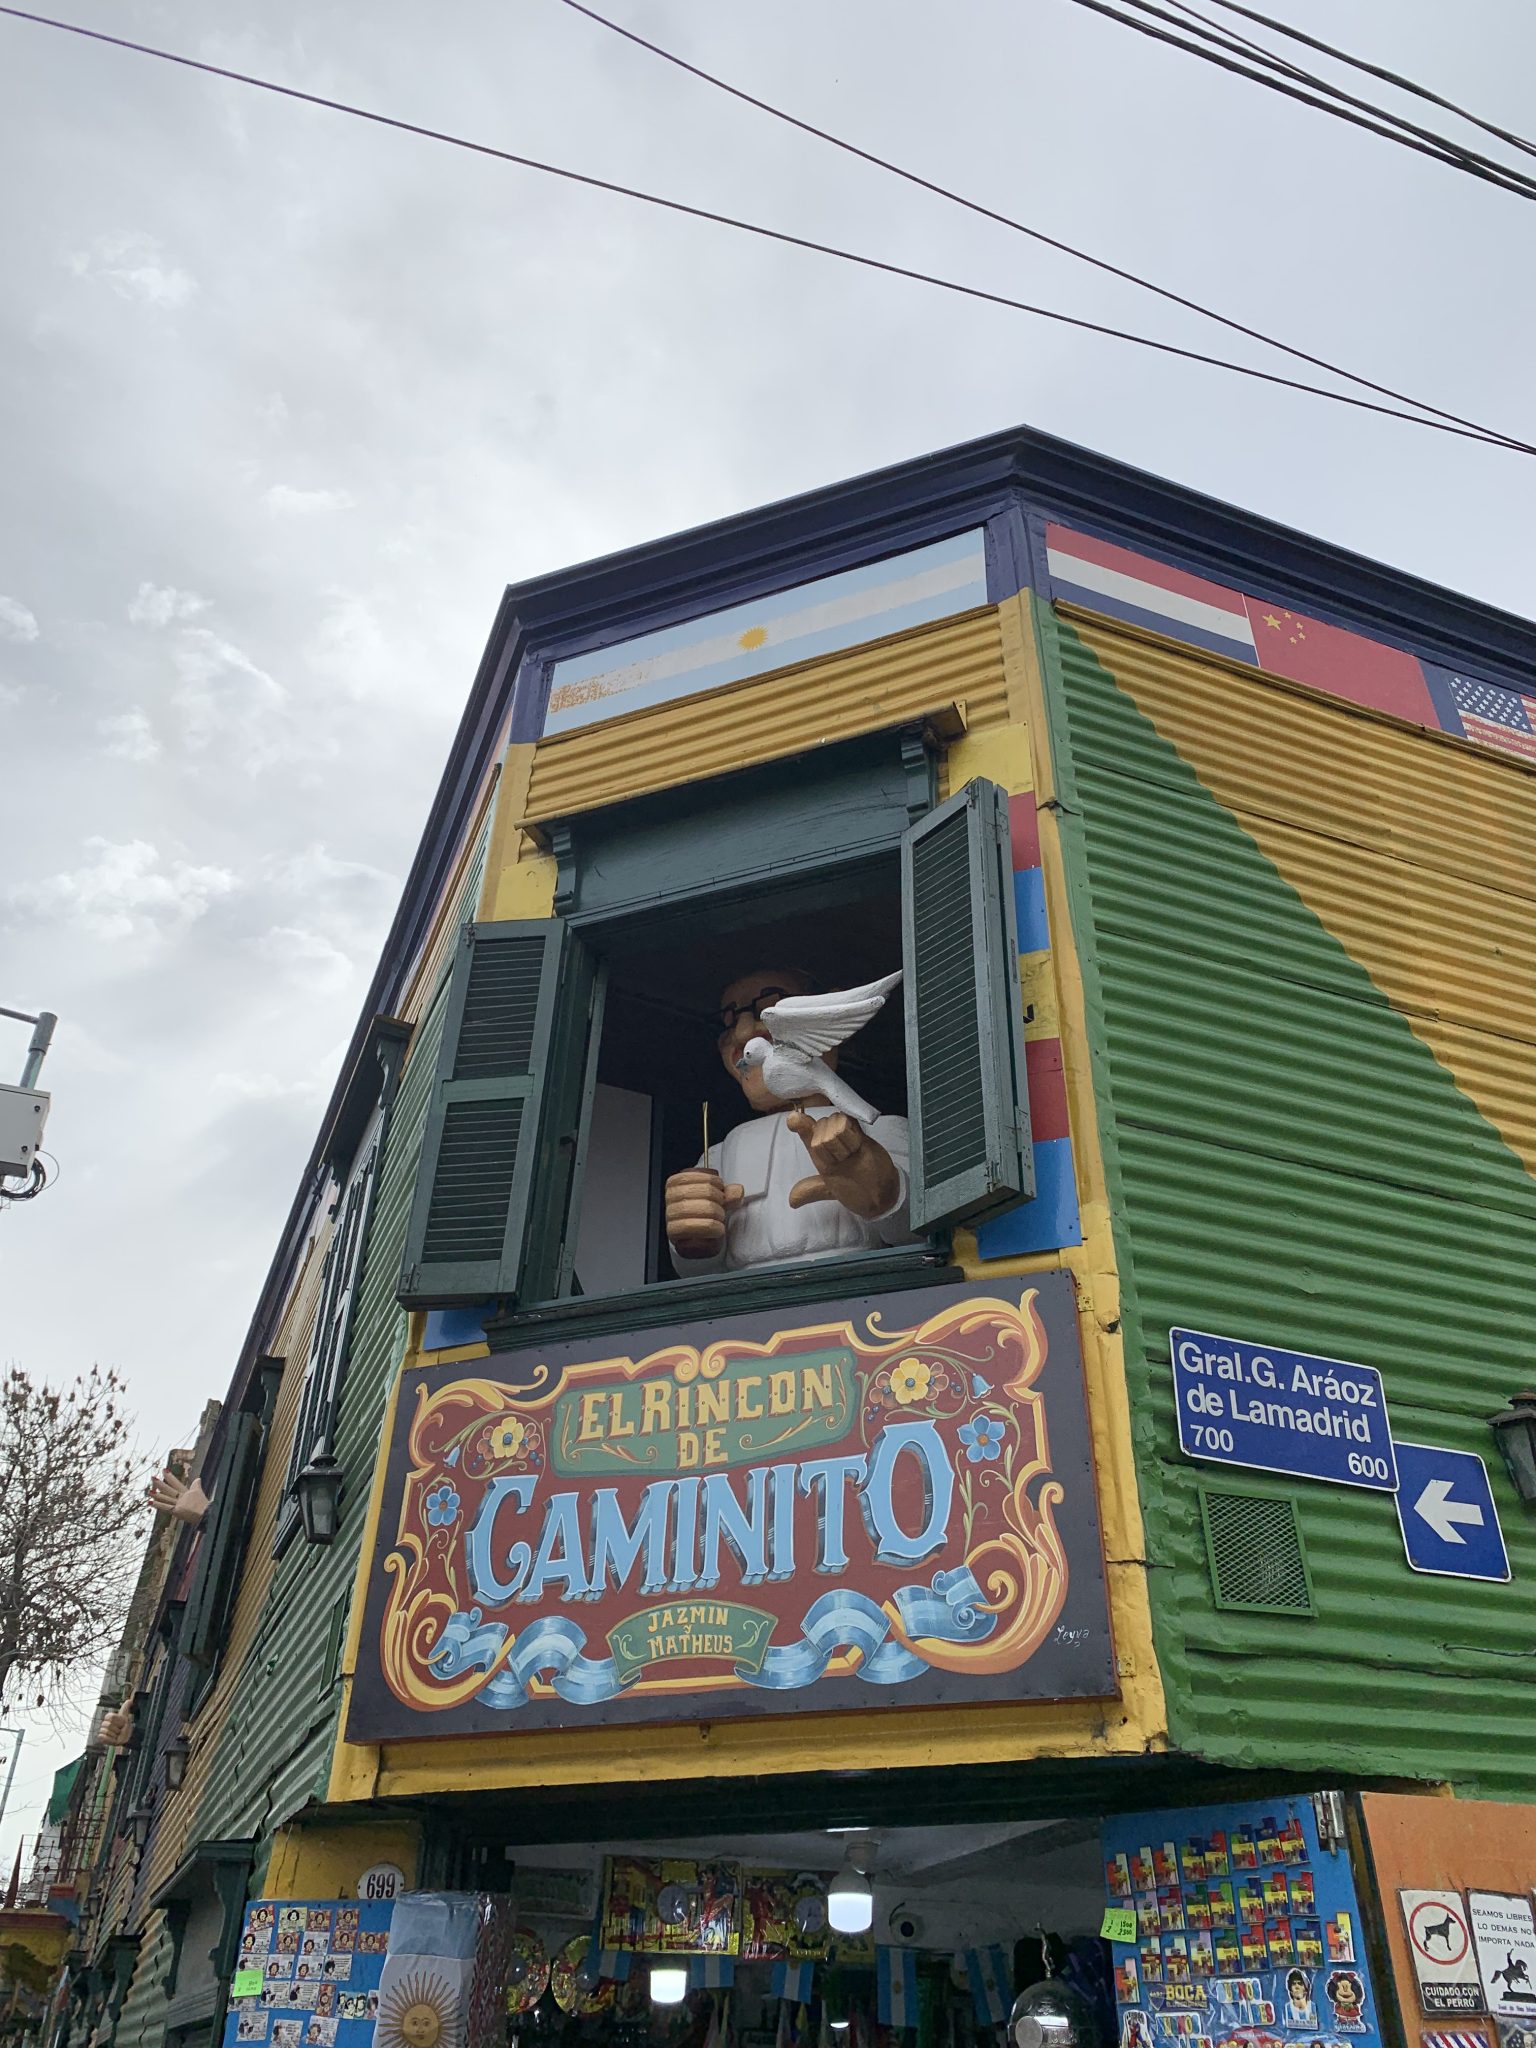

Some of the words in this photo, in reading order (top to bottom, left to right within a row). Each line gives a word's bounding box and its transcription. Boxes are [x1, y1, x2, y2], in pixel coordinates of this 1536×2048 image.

[1291, 1364, 1377, 1407] Aráoz
[1187, 1383, 1224, 1416] de
[1230, 1389, 1371, 1443] Lamadrid
[677, 1427, 729, 1470] DE
[1189, 1424, 1234, 1453] 700
[1348, 1453, 1388, 1480] 600
[464, 1419, 956, 1608] CAMINITO
[647, 1606, 729, 1633] JAZMIN
[647, 1634, 733, 1660] MATHEUS
[366, 1872, 395, 1899] 699
[1472, 1908, 1504, 1919] SEAMOS
[1506, 1913, 1533, 1922] LIBRES
[1477, 1922, 1488, 1930] LO
[1520, 1927, 1532, 1936] NO
[1478, 1935, 1512, 1946] IMPORTA
[1514, 1940, 1535, 1949] NADA
[1165, 1983, 1207, 2001] BOCA
[1425, 1986, 1460, 1997] CUIDADO
[1462, 1987, 1479, 1997] CON
[1434, 1998, 1446, 2007] EL
[1446, 1998, 1475, 2007] PERRO
